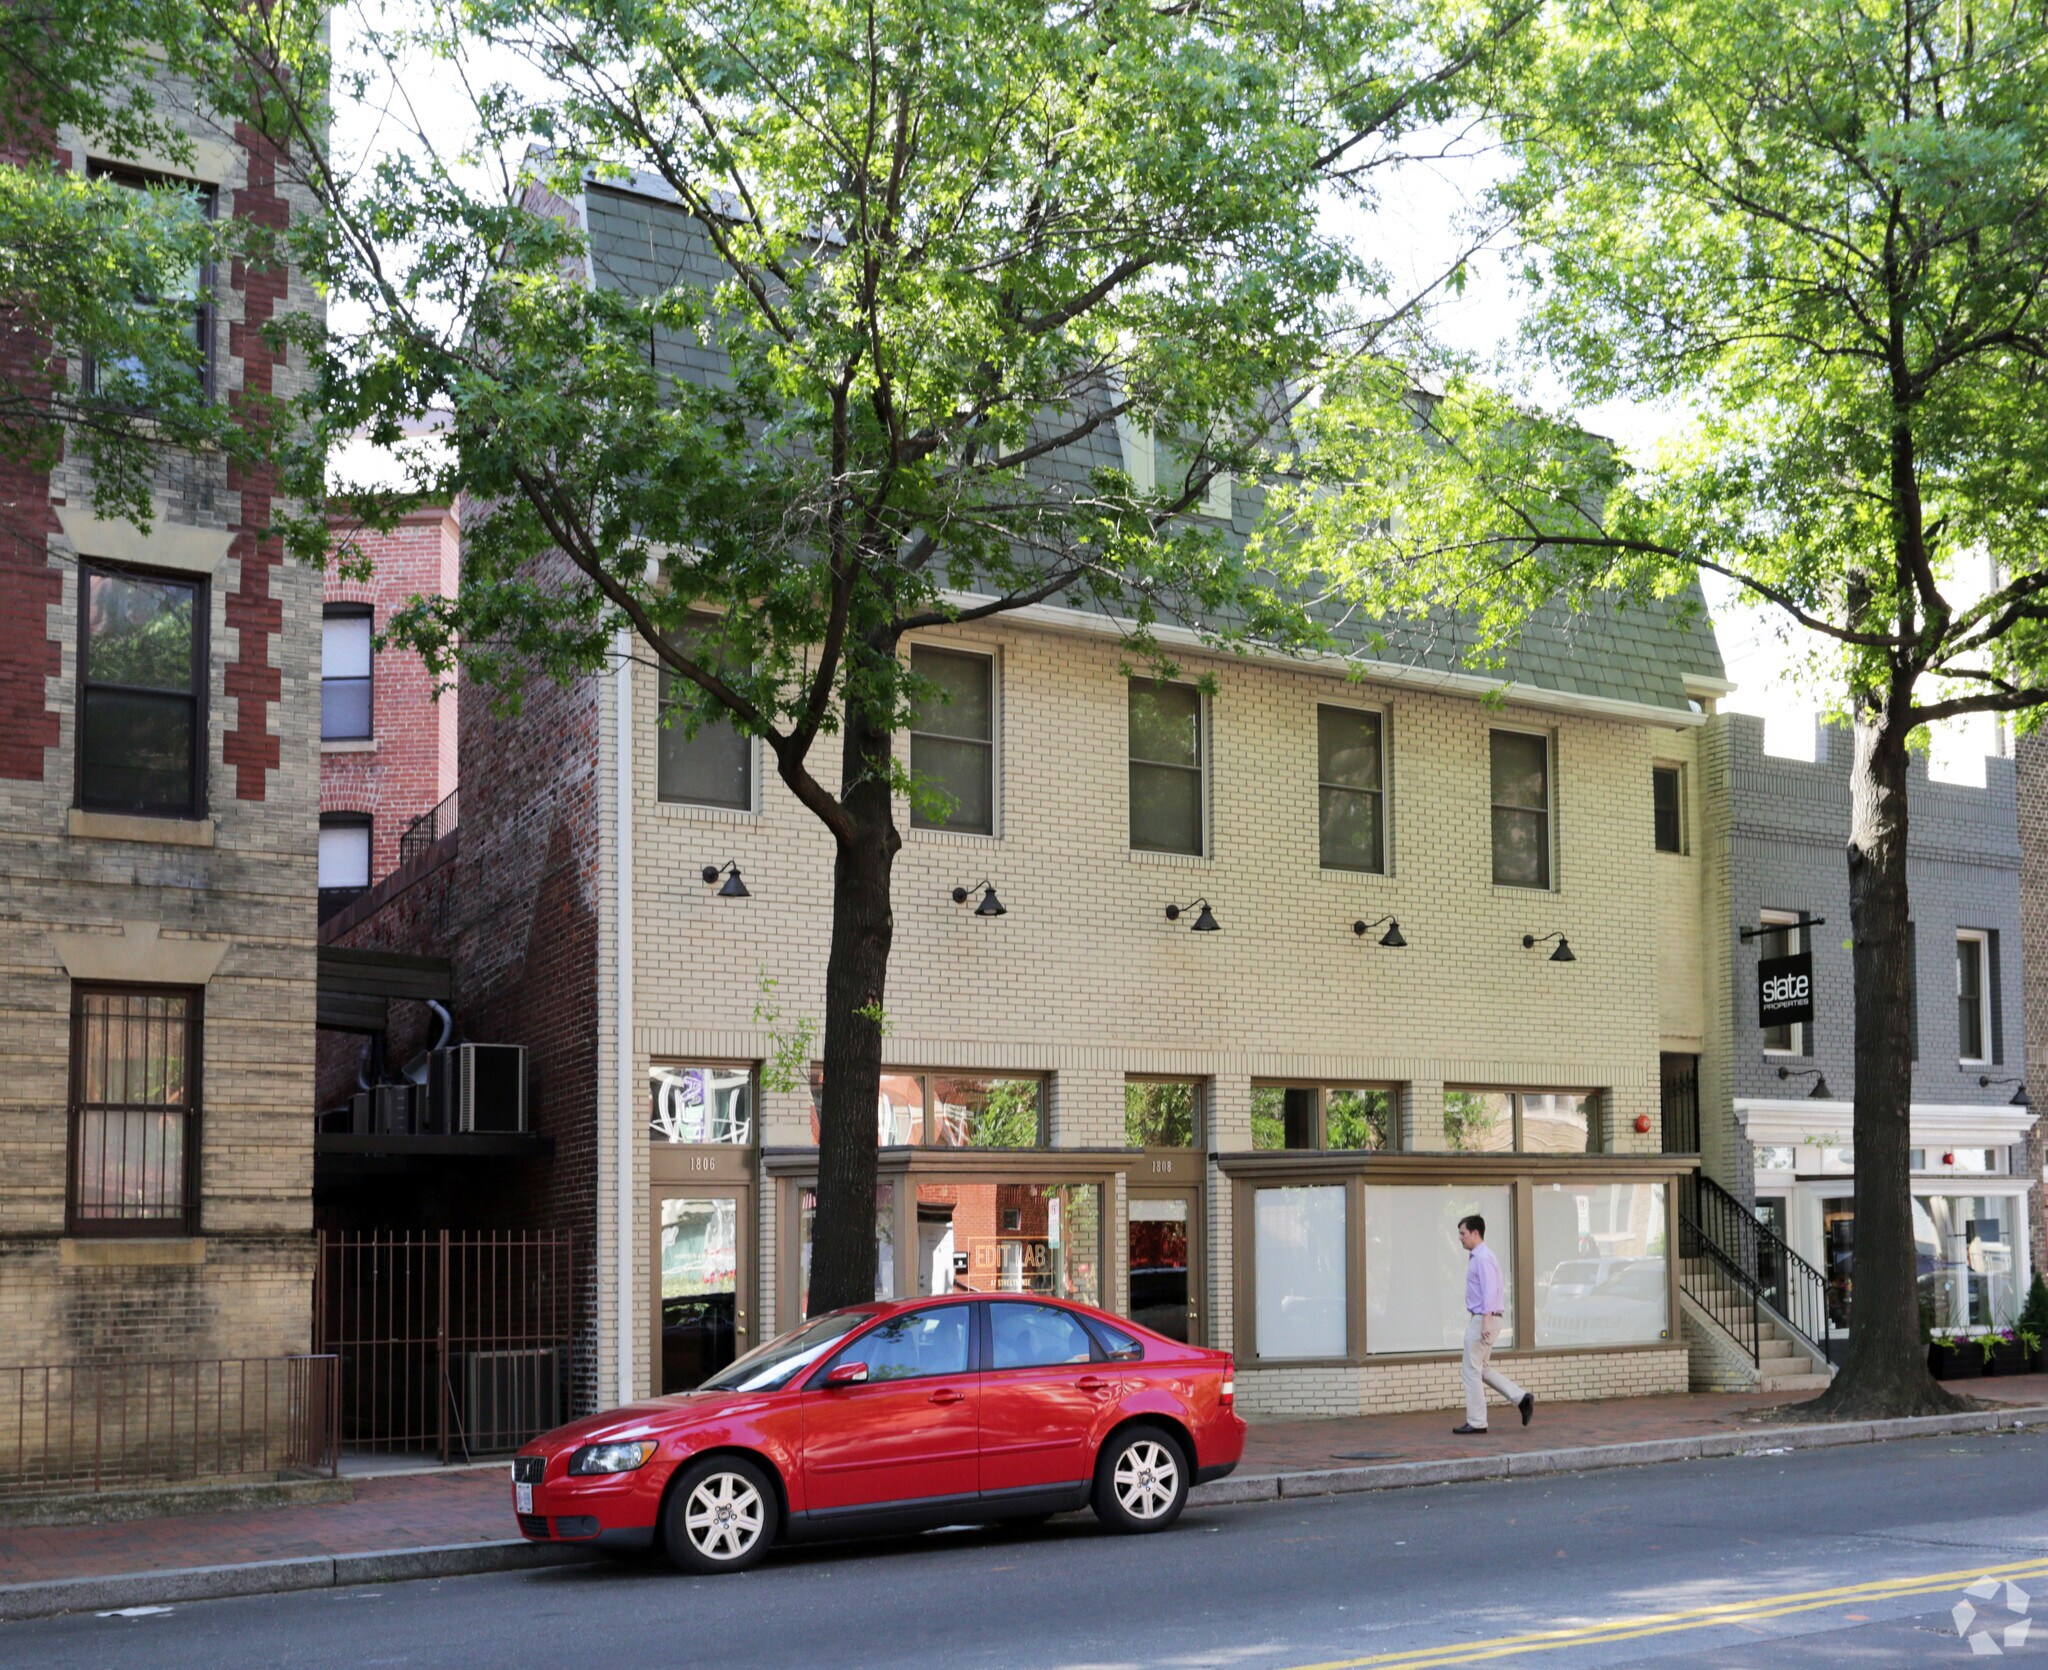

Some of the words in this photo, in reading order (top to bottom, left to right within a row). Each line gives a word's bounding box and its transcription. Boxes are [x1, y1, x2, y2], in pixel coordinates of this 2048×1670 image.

[1763, 973, 1809, 1003] slate
[1763, 998, 1809, 1011] PROPERTIES
[690, 1156, 716, 1172] 1806
[1152, 1160, 1172, 1173] 1808
[975, 1244, 1011, 1268] EDIT
[1015, 1244, 1046, 1268] LAB
